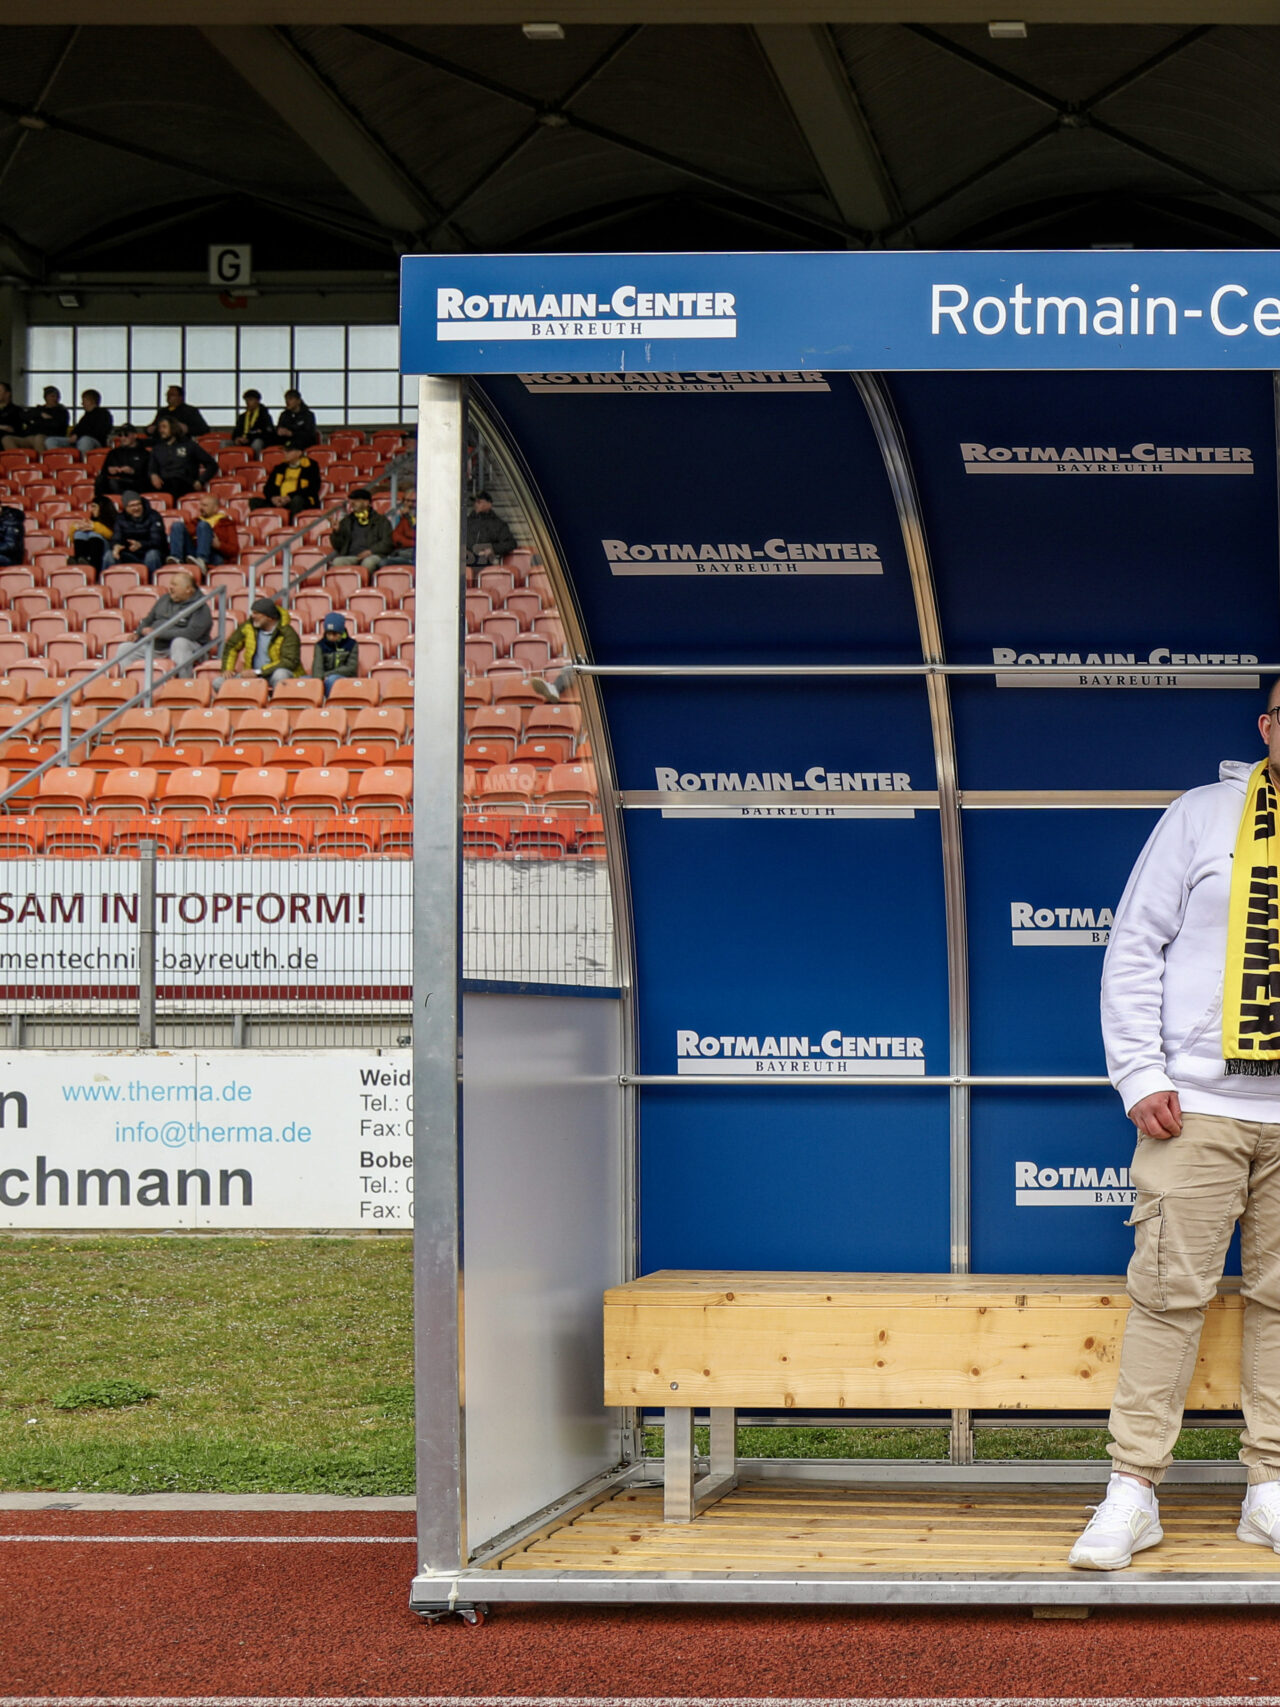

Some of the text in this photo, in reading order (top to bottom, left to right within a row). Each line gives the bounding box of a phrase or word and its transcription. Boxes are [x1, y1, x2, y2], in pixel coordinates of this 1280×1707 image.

[217, 249, 241, 282] G
[437, 286, 736, 319] ROTMAIN-CENTER
[531, 322, 642, 336] BAYREUTH
[622, 384, 737, 392] BAYREUTH
[959, 442, 1254, 462] ROTMAIN-CENTER
[1056, 464, 1164, 473] BAYREUTH
[602, 538, 881, 561] ROTMAIN-CENTER
[695, 563, 798, 573] BAYREUTH
[1079, 675, 1178, 686] BAYREUTH
[655, 767, 913, 791] ROTMAIN-CENTER
[101, 893, 138, 924] IN
[155, 893, 366, 925] TOPFORM!
[0, 947, 319, 975] mentechni-bayreuth.de
[677, 1030, 925, 1057] ROTMAIN-CENTER
[755, 1061, 848, 1072] BAYREUTH
[62, 1080, 252, 1102] www.therma.de
[360, 1094, 398, 1112] Tel.:
[115, 1121, 312, 1148] info@therma.de
[360, 1119, 401, 1137] Fax:
[0, 1156, 252, 1206] chmann
[360, 1176, 398, 1193] Tel.:
[1016, 1162, 1135, 1188] ROTMAI
[360, 1201, 400, 1219] Fax:
